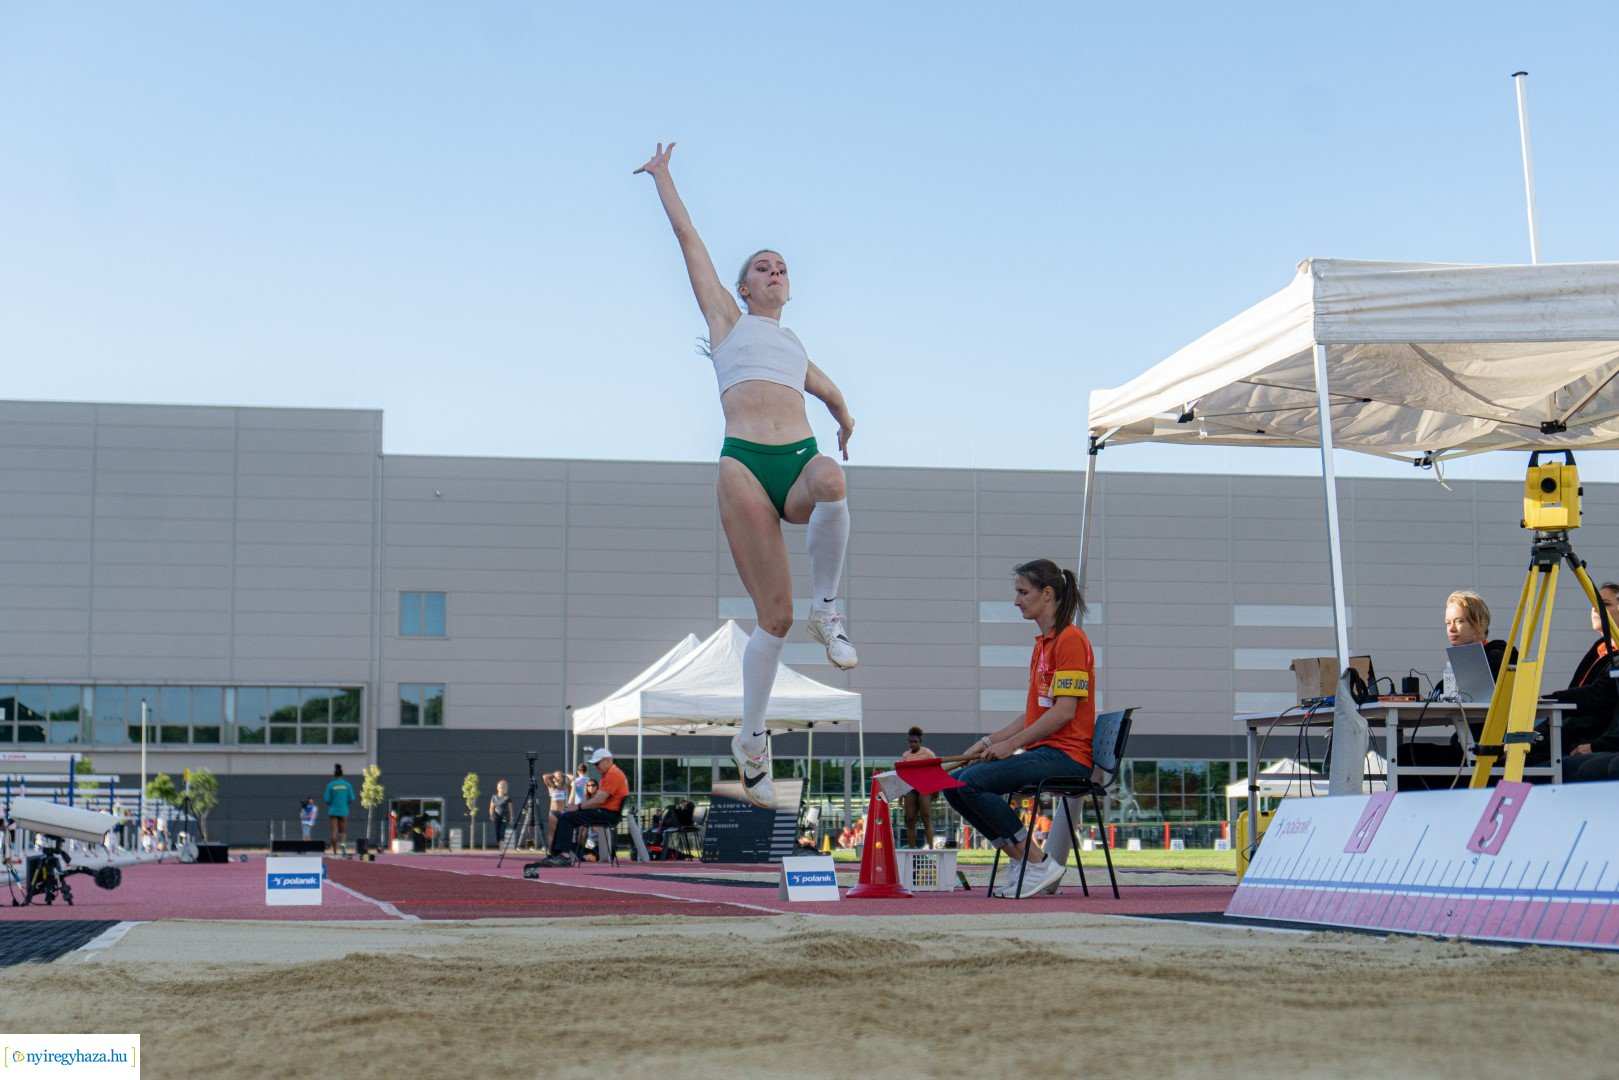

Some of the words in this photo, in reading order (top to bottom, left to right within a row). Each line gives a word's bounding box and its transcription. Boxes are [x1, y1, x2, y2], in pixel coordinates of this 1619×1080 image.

[1057, 678, 1073, 689] CHIEF
[1356, 804, 1381, 849] 4
[1478, 796, 1513, 849] 5
[283, 877, 316, 886] polanik
[802, 875, 832, 883] polanik
